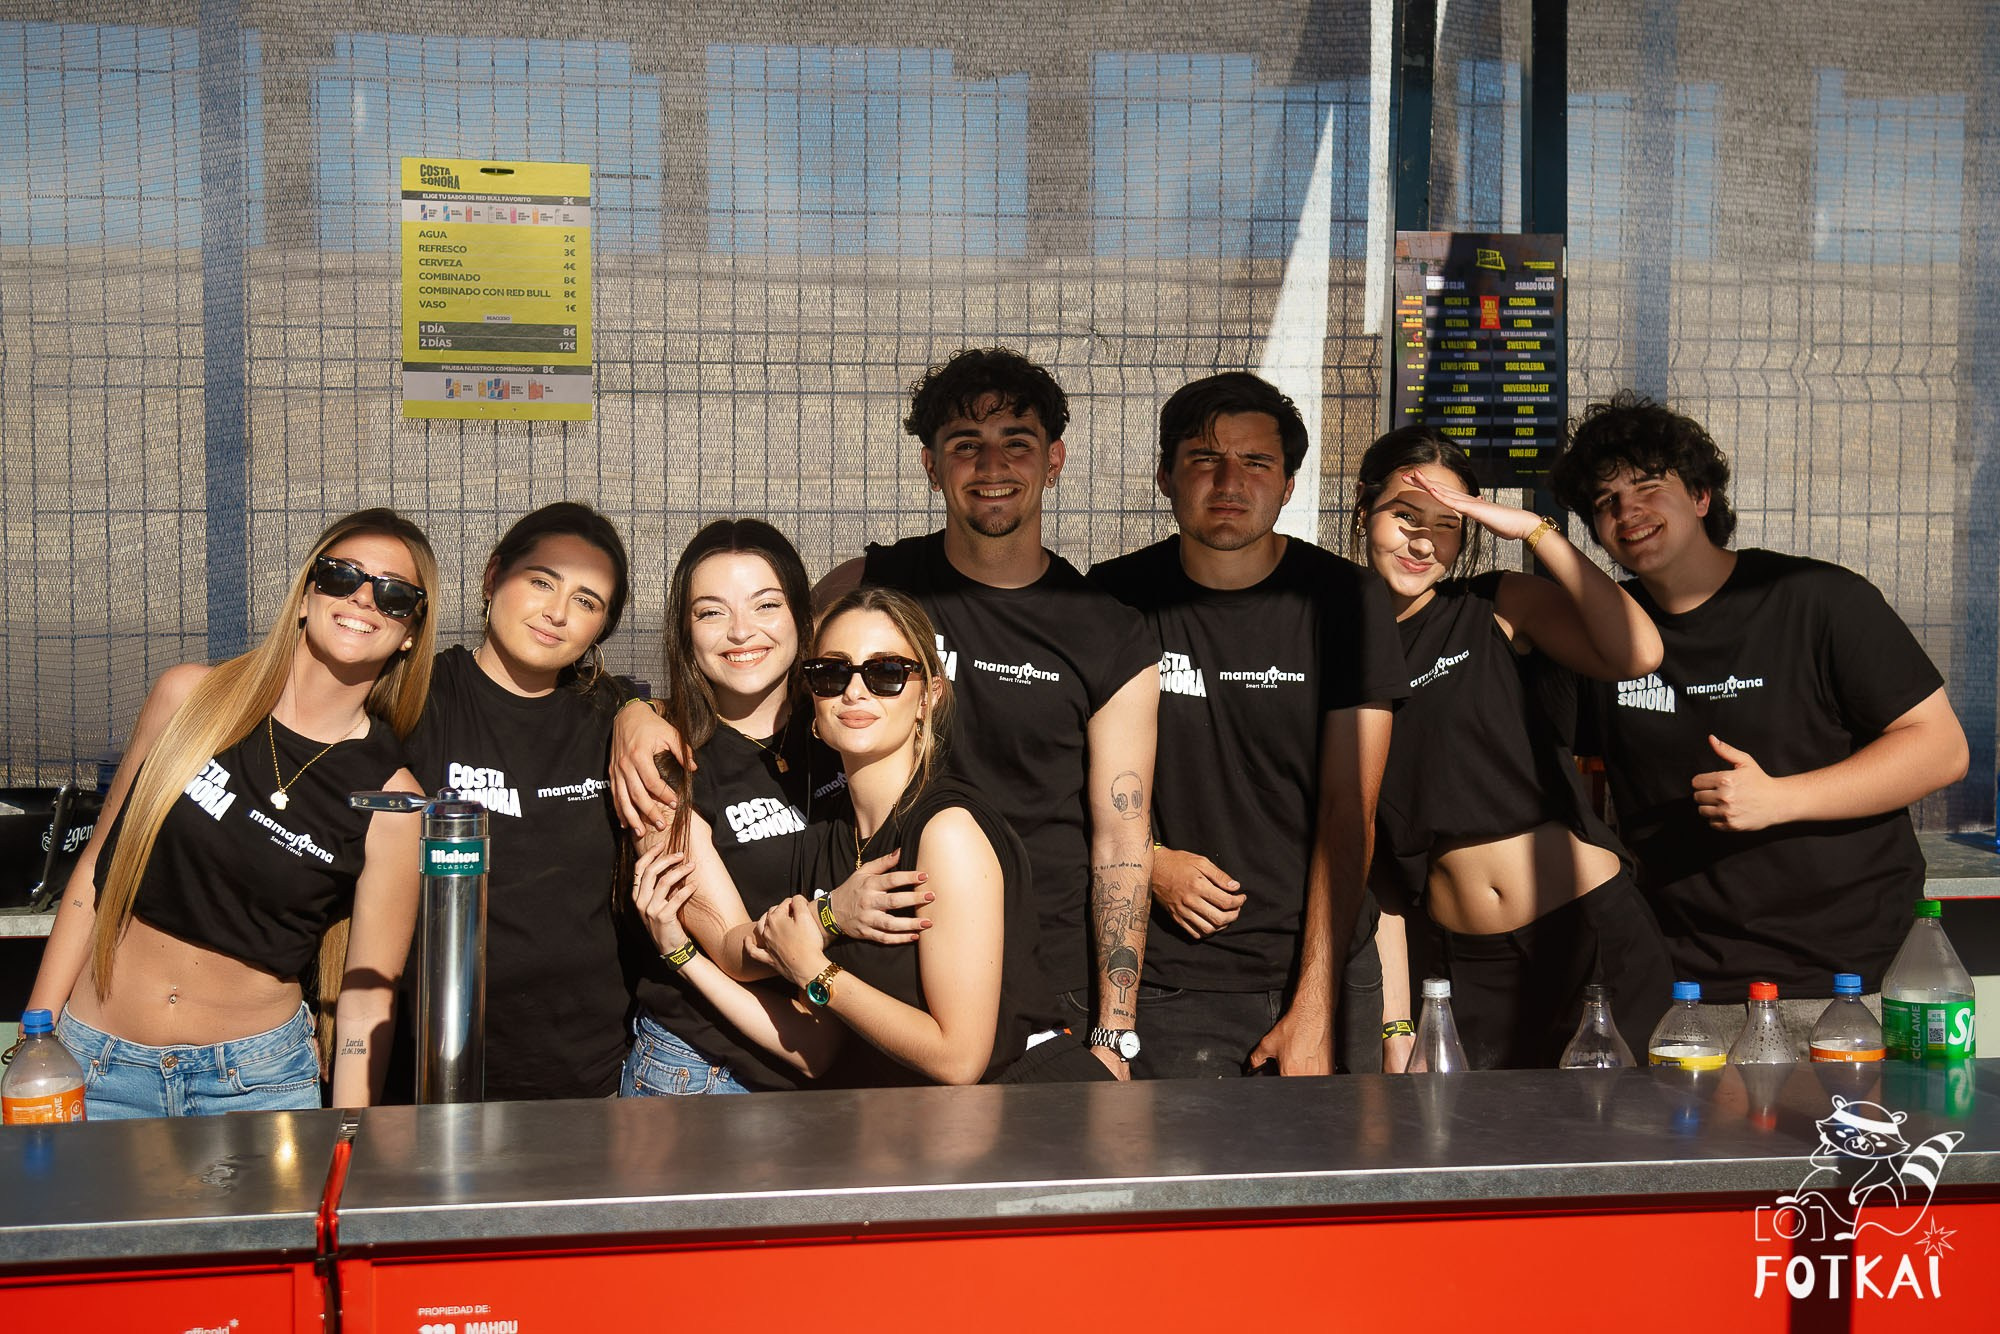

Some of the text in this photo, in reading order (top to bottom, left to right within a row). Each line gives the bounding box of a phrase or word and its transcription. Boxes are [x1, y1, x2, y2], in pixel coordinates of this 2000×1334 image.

[420, 164, 451, 177] COSTA
[421, 176, 460, 190] SONORA
[563, 197, 574, 205] 3€
[418, 230, 447, 239] AGUA
[419, 245, 467, 254] REFRESCO
[419, 258, 462, 267] CERVEZA
[419, 272, 480, 282] COMBINADO
[419, 286, 480, 296] COMBINADO
[483, 288, 505, 296] CON
[506, 289, 525, 297] RED
[527, 289, 551, 297] BULL
[419, 300, 446, 309] VASO
[427, 324, 446, 333] DÍA
[428, 338, 452, 347] DÍAS
[1160, 668, 1206, 697] NORA
[1618, 685, 1675, 713] SONORA
[449, 762, 504, 789] COSTA
[725, 798, 785, 832] COSTA
[736, 805, 807, 843] SONORA
[431, 849, 479, 863] Mahou
[418, 1304, 491, 1316] PROPIEDAD DE:
